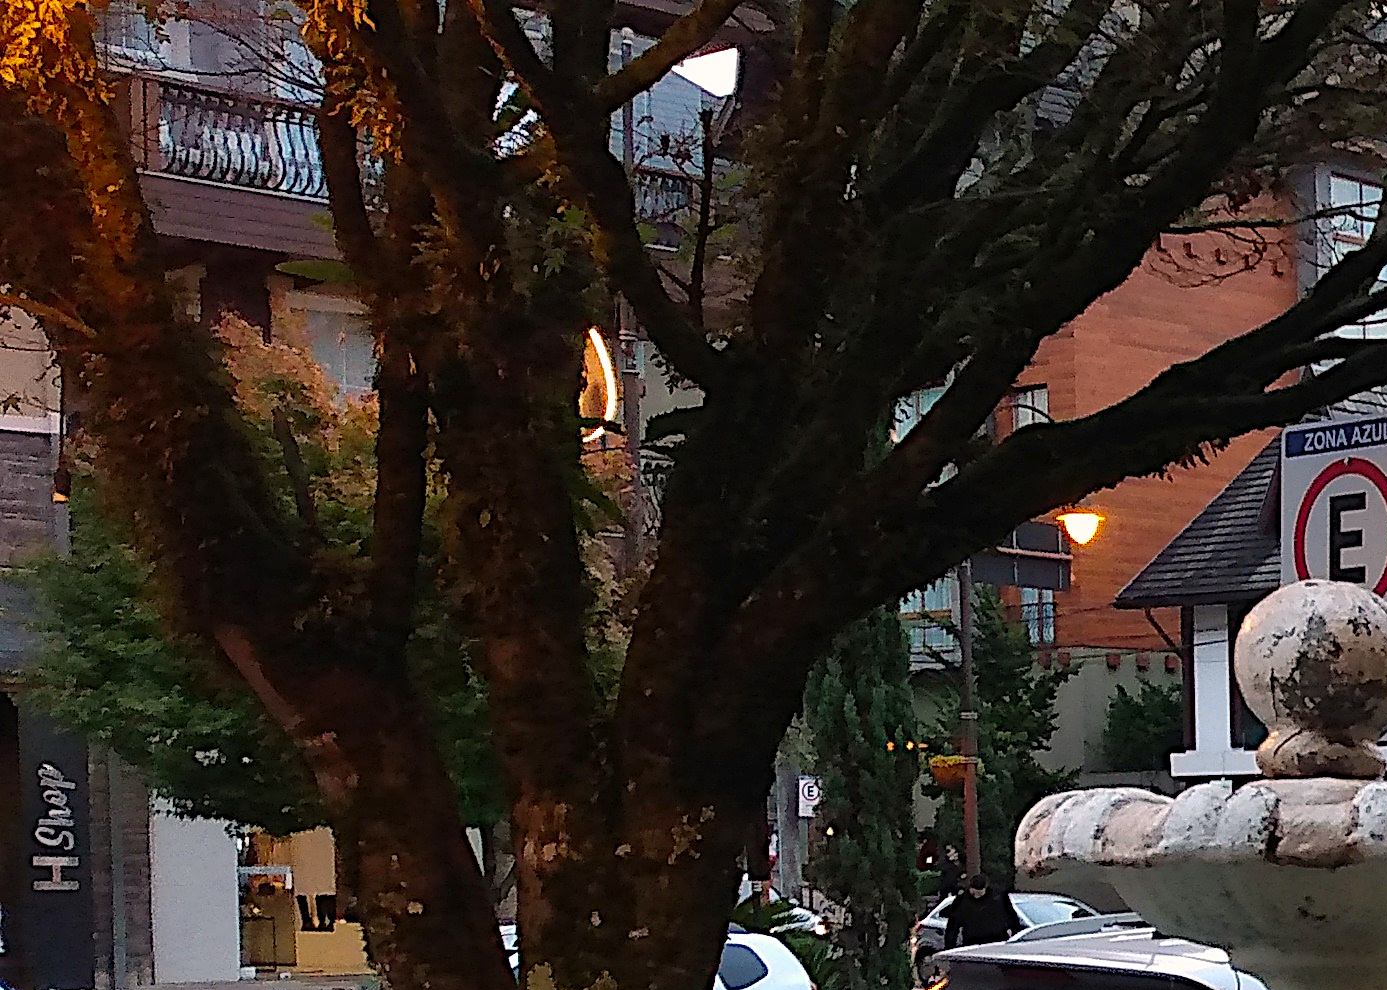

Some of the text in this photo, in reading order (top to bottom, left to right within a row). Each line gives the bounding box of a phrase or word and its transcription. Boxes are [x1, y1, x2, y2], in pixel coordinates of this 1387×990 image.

[1304, 428, 1348, 451] ZONA
[1329, 491, 1367, 584] E
[34, 763, 77, 851] Shop
[807, 785, 815, 798] E
